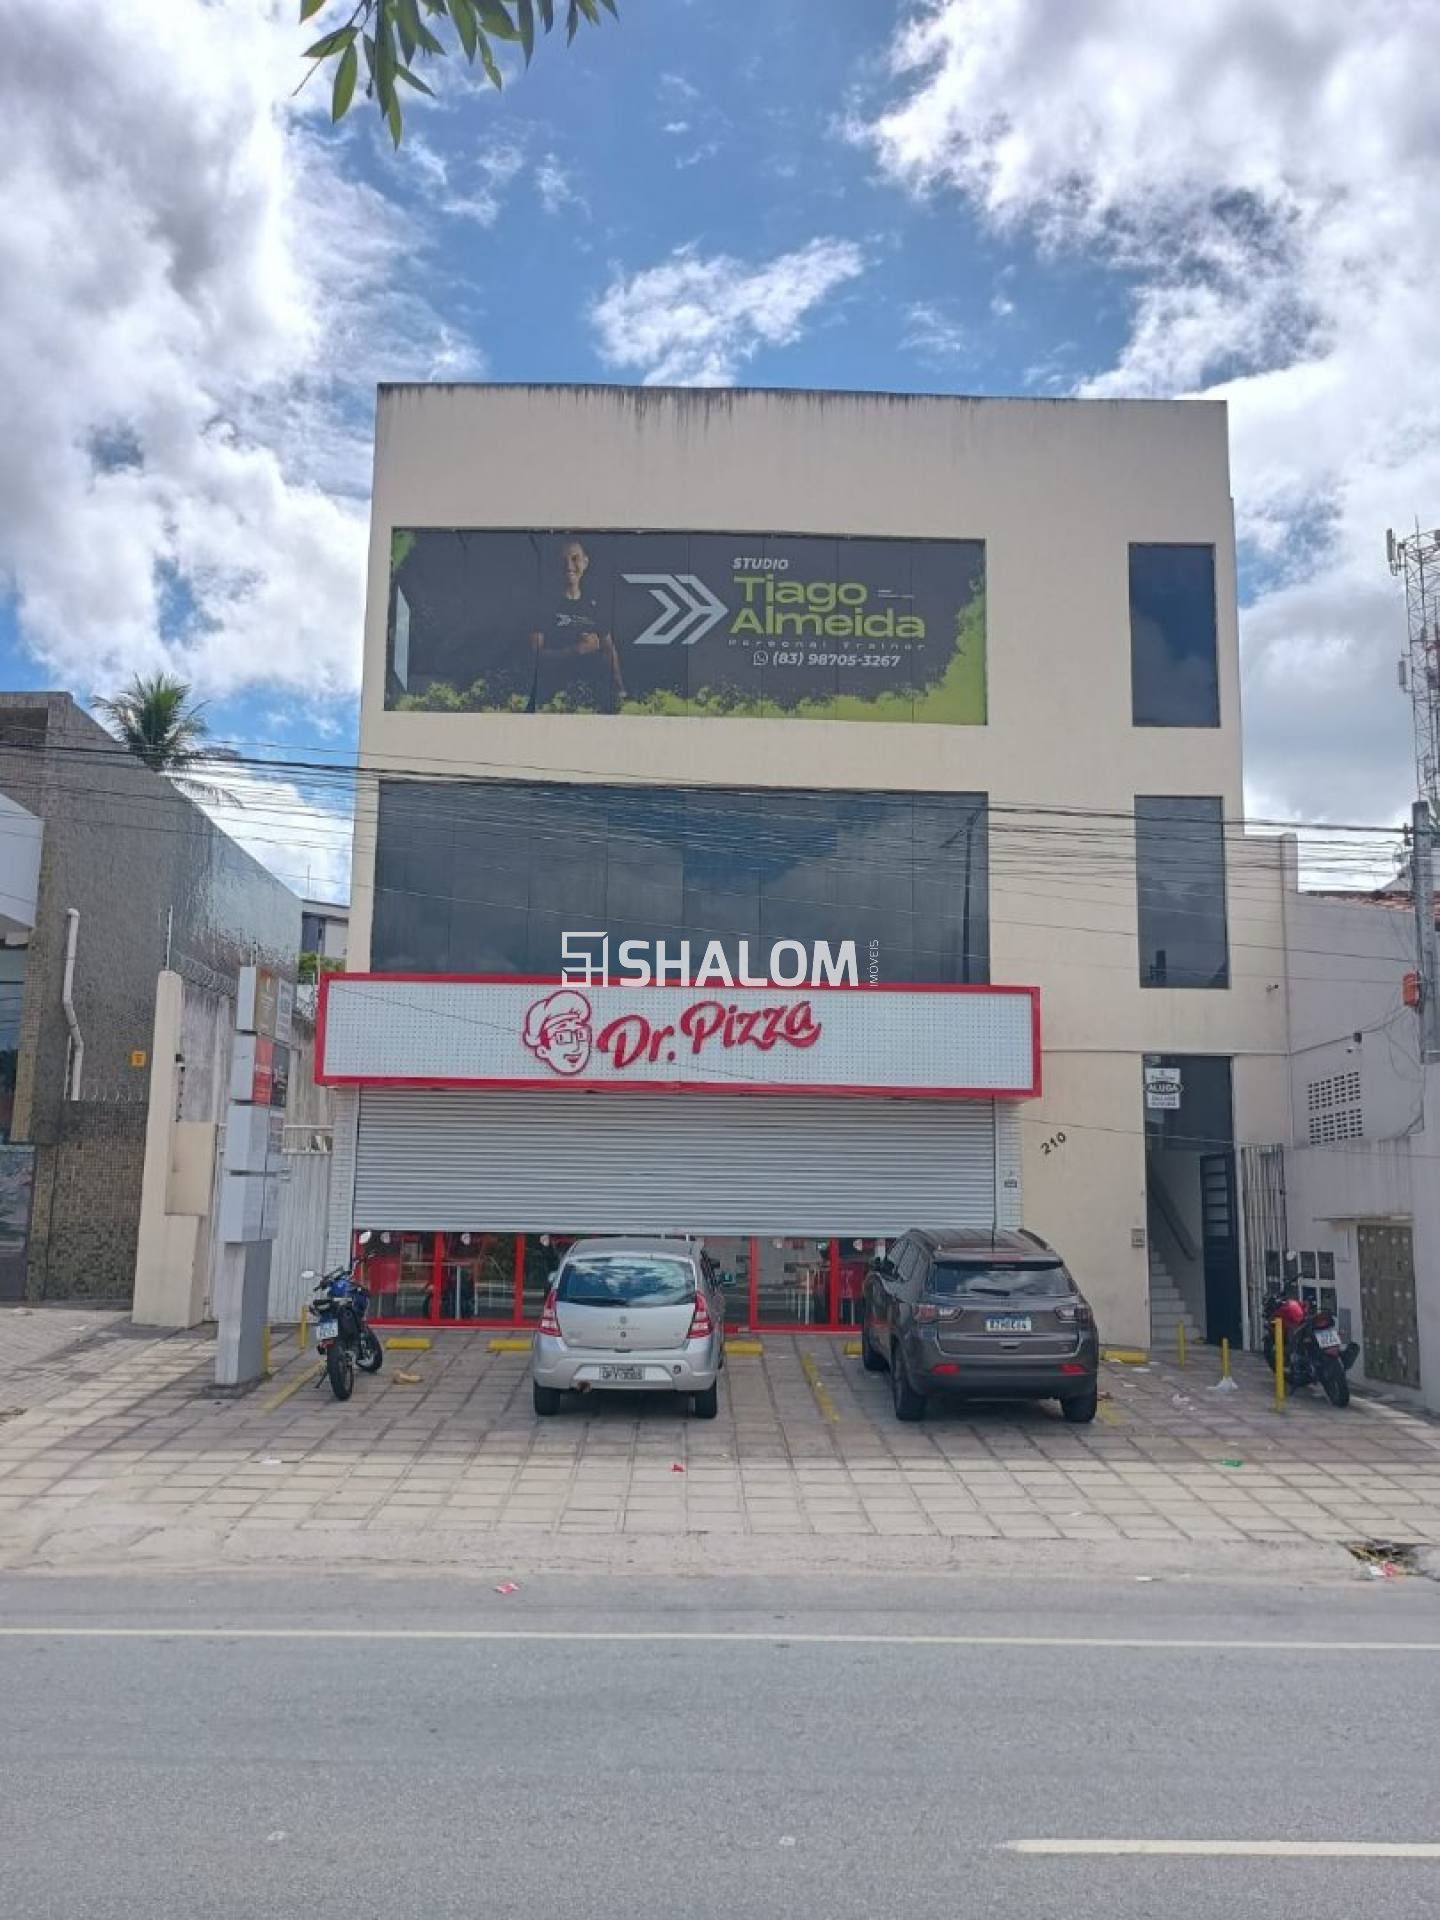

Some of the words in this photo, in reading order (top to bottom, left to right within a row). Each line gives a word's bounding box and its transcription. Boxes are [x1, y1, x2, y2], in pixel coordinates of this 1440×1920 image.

[732, 557, 789, 571] STUDIO
[733, 574, 868, 612] Tiago
[729, 607, 926, 639] Almeida
[772, 651, 804, 667] (83)
[596, 1014, 676, 1069] Dr.
[679, 1000, 823, 1055] Pizza
[1040, 1131, 1068, 1156] 210
